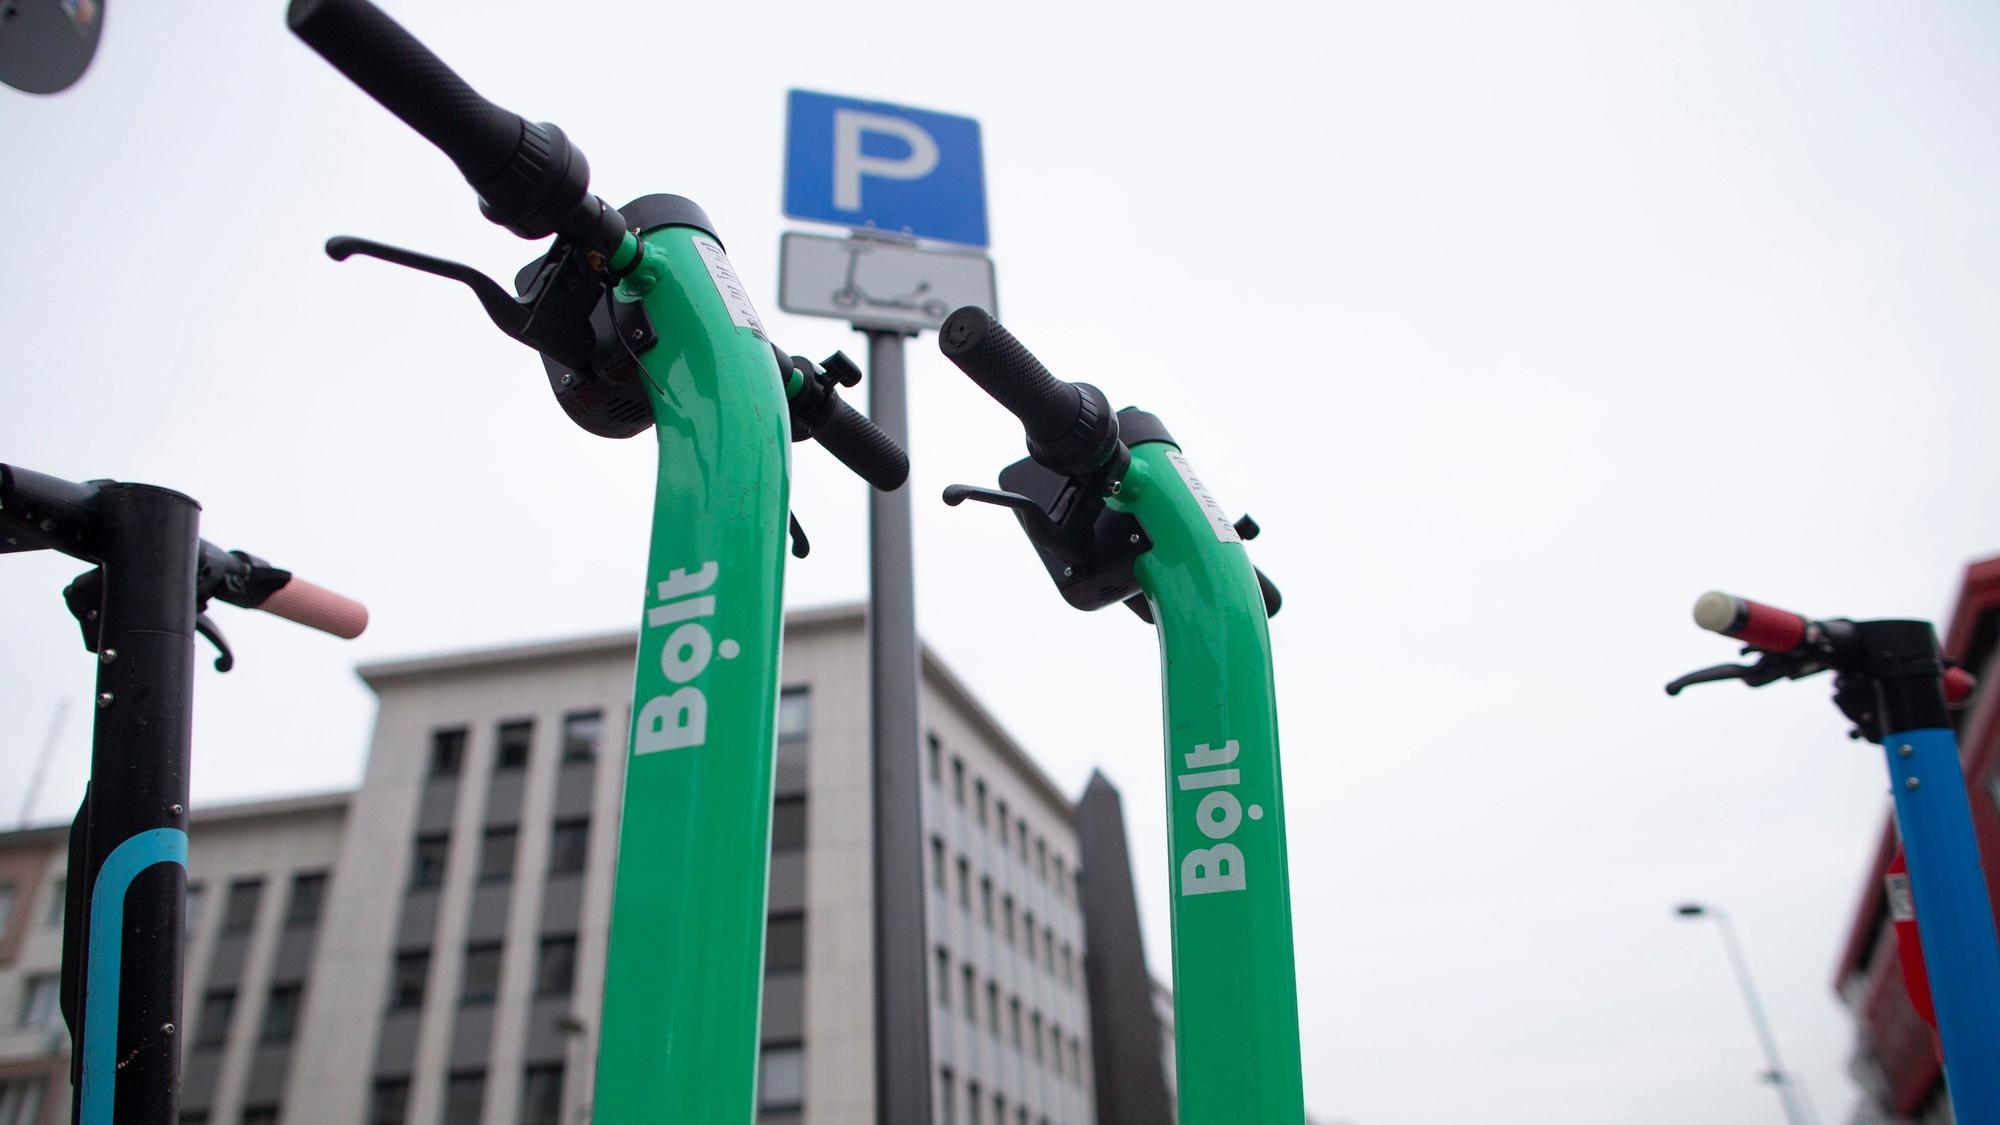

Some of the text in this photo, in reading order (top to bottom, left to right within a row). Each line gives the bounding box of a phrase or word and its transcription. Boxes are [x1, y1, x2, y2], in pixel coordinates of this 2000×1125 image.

[833, 108, 941, 212] P
[634, 560, 741, 756] Bolt
[1178, 739, 1264, 896] Bolt
